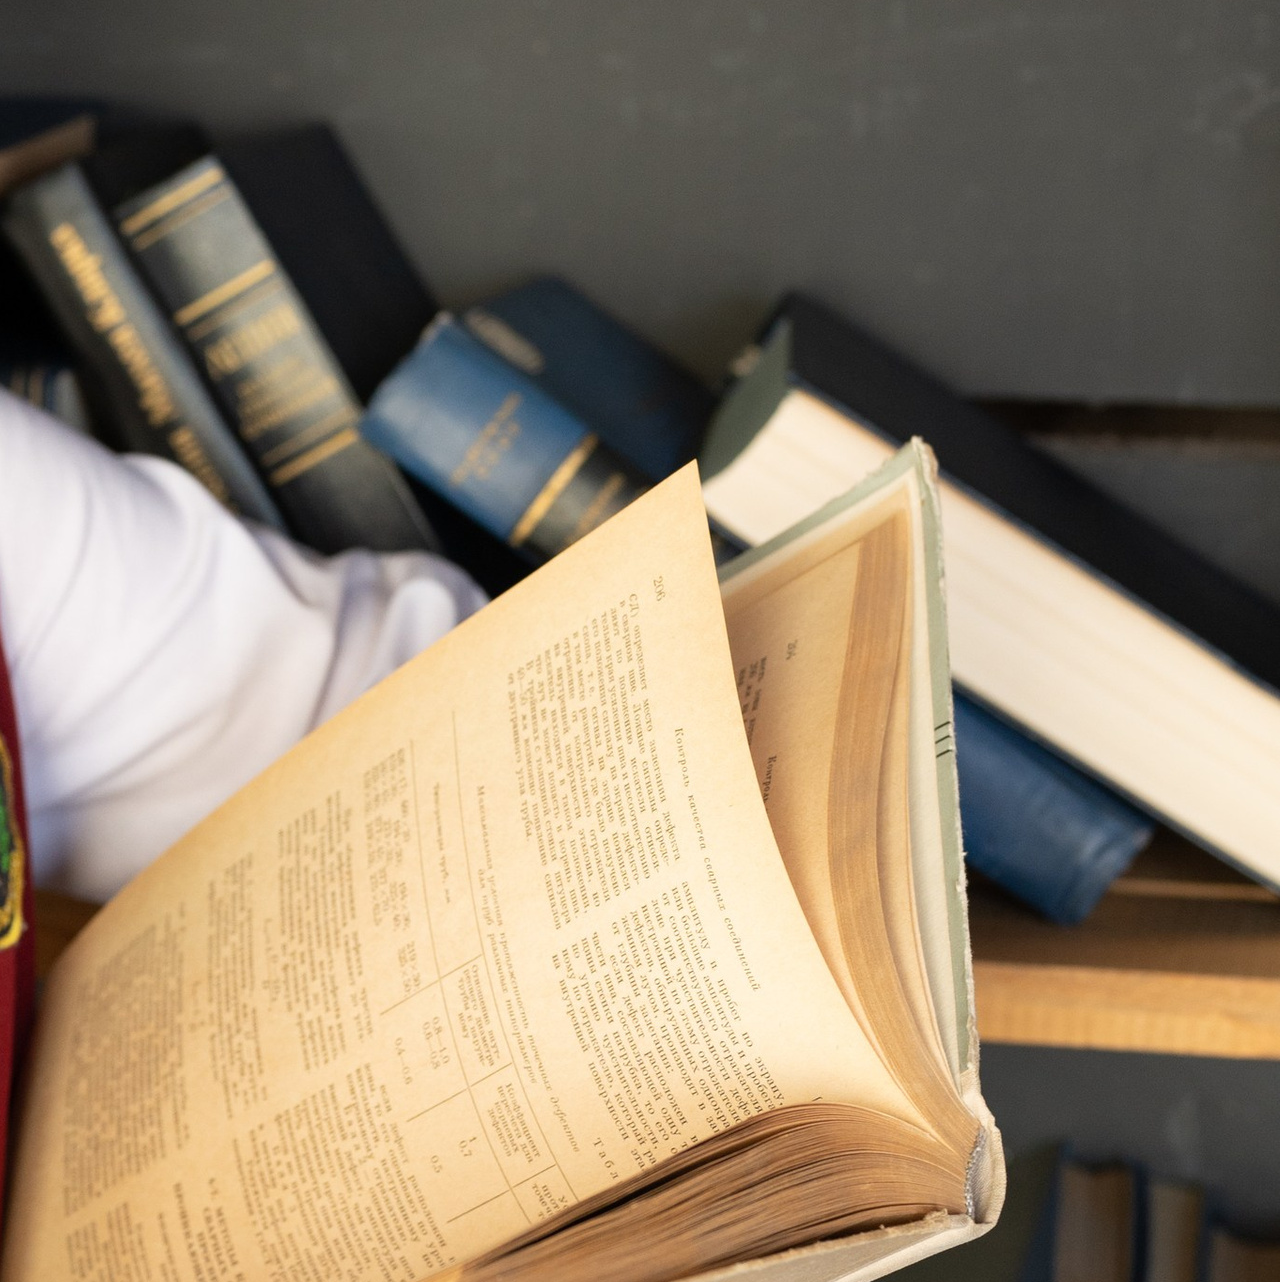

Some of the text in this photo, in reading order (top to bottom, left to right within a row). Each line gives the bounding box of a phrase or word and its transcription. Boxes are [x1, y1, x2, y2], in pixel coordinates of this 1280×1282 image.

[609, 607, 619, 636] ляют
[653, 574, 667, 602] 206
[552, 643, 560, 657] на
[573, 643, 582, 664] том
[590, 618, 599, 637] его
[614, 648, 623, 663] по
[553, 666, 571, 735] внутренней
[576, 669, 586, 701] месте
[593, 640, 607, 706] положения
[590, 705, 602, 747] сигнал
[599, 709, 614, 758] сигналу
[618, 675, 634, 745] положению
[618, 613, 633, 663] сварном
[632, 703, 648, 754] Ложные
[641, 760, 658, 813] сигналы
[629, 592, 682, 861] СД) определяет место залегания дефекта
[560, 637, 611, 903] отражение от контрольного отражателя
[597, 755, 606, 771] на
[599, 612, 651, 879] тельно края усиления шва и несоответствию
[609, 765, 618, 780] на
[562, 743, 582, 819] поверхности
[587, 776, 599, 797] где
[599, 779, 616, 823] экране
[610, 784, 627, 827] экране
[629, 757, 647, 812] искателя
[593, 800, 608, 833] было
[599, 837, 621, 897] получено
[611, 831, 631, 890] появился
[673, 727, 761, 992] Контроль качества сварных соединений
[591, 891, 601, 907] но
[570, 943, 581, 959] по
[578, 973, 602, 1022] уровню
[610, 921, 673, 1073] от глубины залегания:
[638, 903, 676, 985] настроенной
[671, 988, 682, 1005] по
[677, 1008, 700, 1047] этому
[649, 899, 665, 928] лоне
[660, 935, 677, 961] при
[673, 967, 730, 1082] чувствительности
[678, 880, 710, 950] амплитуду
[709, 960, 718, 969] и
[715, 978, 743, 1023] пробег
[741, 1031, 754, 1048] по
[589, 931, 607, 967] части
[614, 1008, 663, 1102] составляющей
[658, 1105, 681, 1138] одну
[619, 916, 642, 967] женным
[658, 1024, 698, 1098] производит
[696, 1101, 706, 1111] в
[660, 892, 763, 1116] от соответствующего отражателя
[670, 887, 778, 1113] или большие амплитуды и пробега
[551, 954, 647, 1172] на внутренней поверхности эта
[559, 948, 576, 980] ному
[572, 985, 583, 1001] по
[612, 1091, 648, 1147] который
[641, 1147, 657, 1167] ра
[578, 937, 597, 974] щины
[594, 980, 615, 1023] стенки
[643, 1099, 656, 1115] то
[654, 1119, 671, 1141] его
[608, 954, 699, 1145] если дефект расположен в
[651, 976, 701, 1074] обнаруженных
[695, 1077, 731, 1131] однокра
